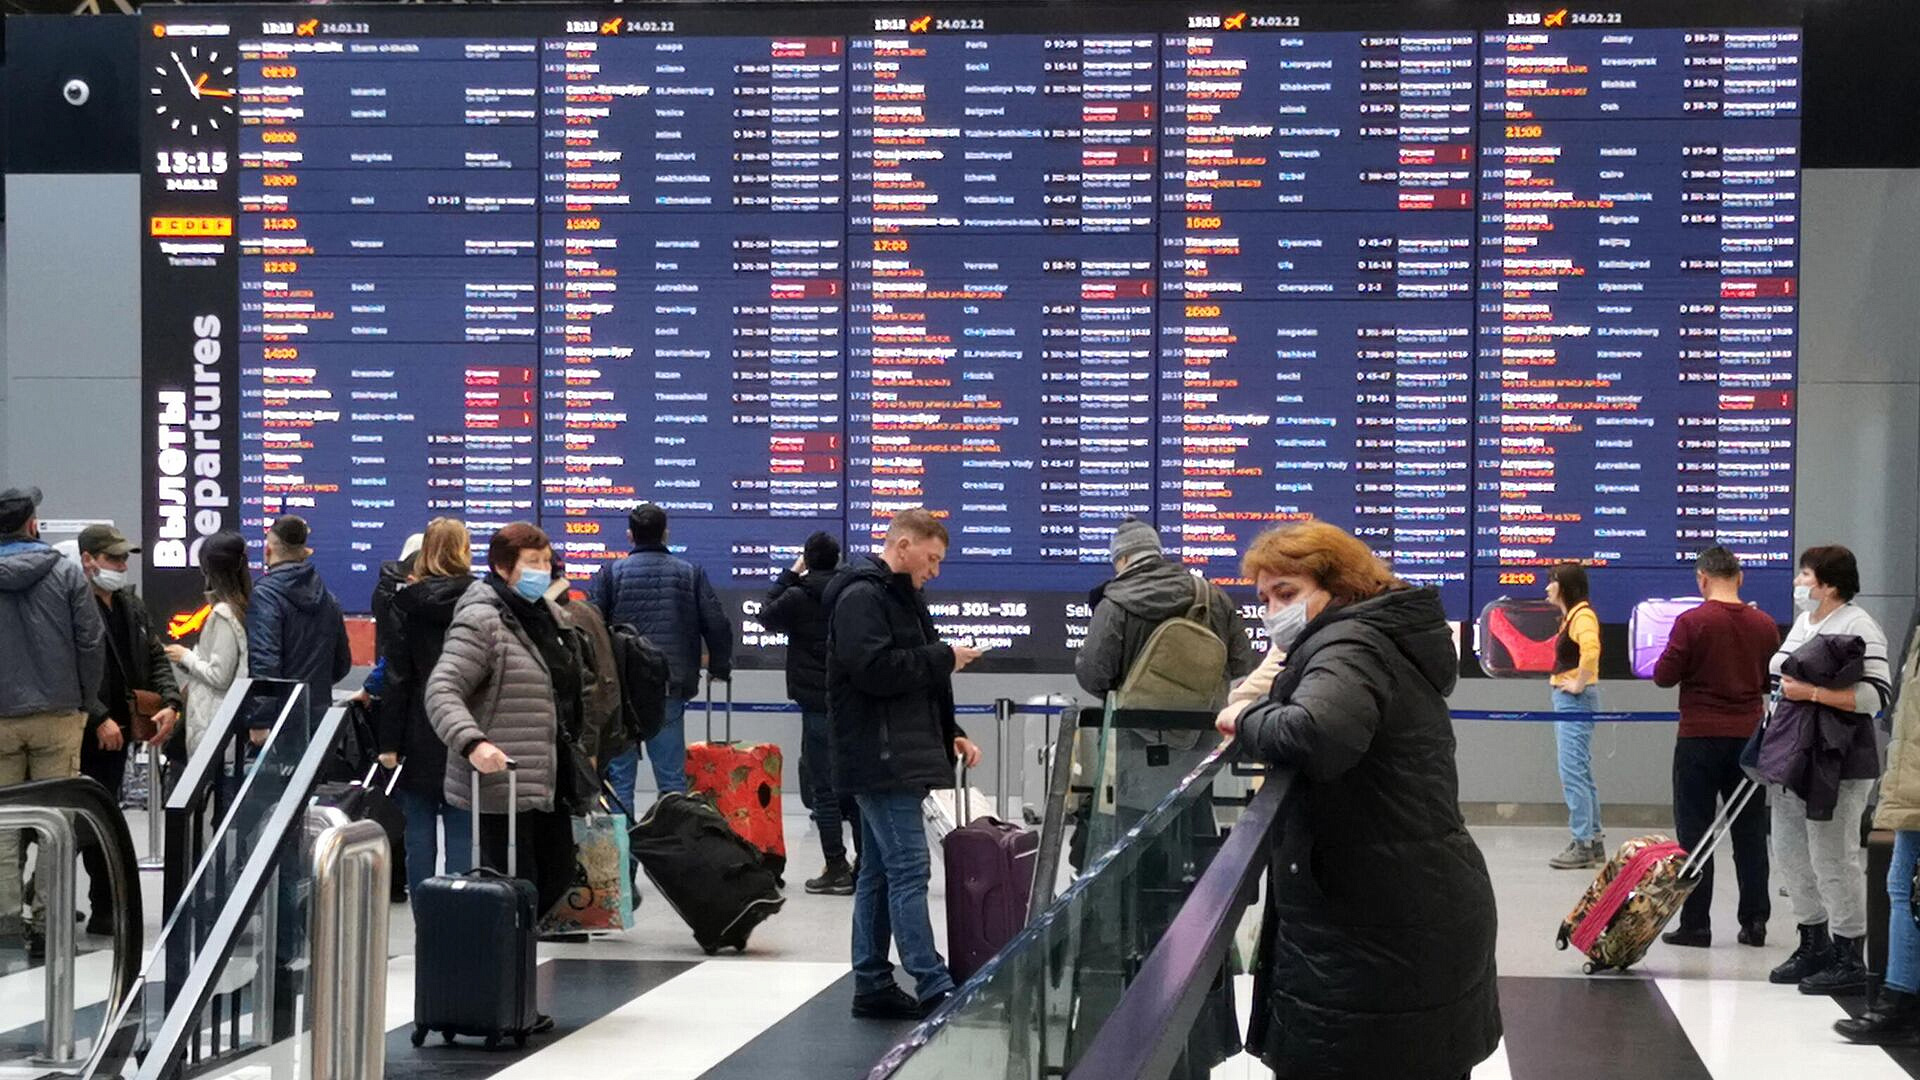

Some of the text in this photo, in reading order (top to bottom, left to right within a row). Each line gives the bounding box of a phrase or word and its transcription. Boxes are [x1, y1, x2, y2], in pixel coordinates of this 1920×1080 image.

[1189, 17, 1299, 27] 13:15 24.02.22
[1508, 13, 1621, 24] 13:15 24.02.22
[263, 22, 369, 34] 13:15 24.02.22
[567, 21, 674, 32] 13:15 24.02.22
[875, 19, 984, 30] 13:15 24.02.22
[157, 152, 228, 173] 13:15
